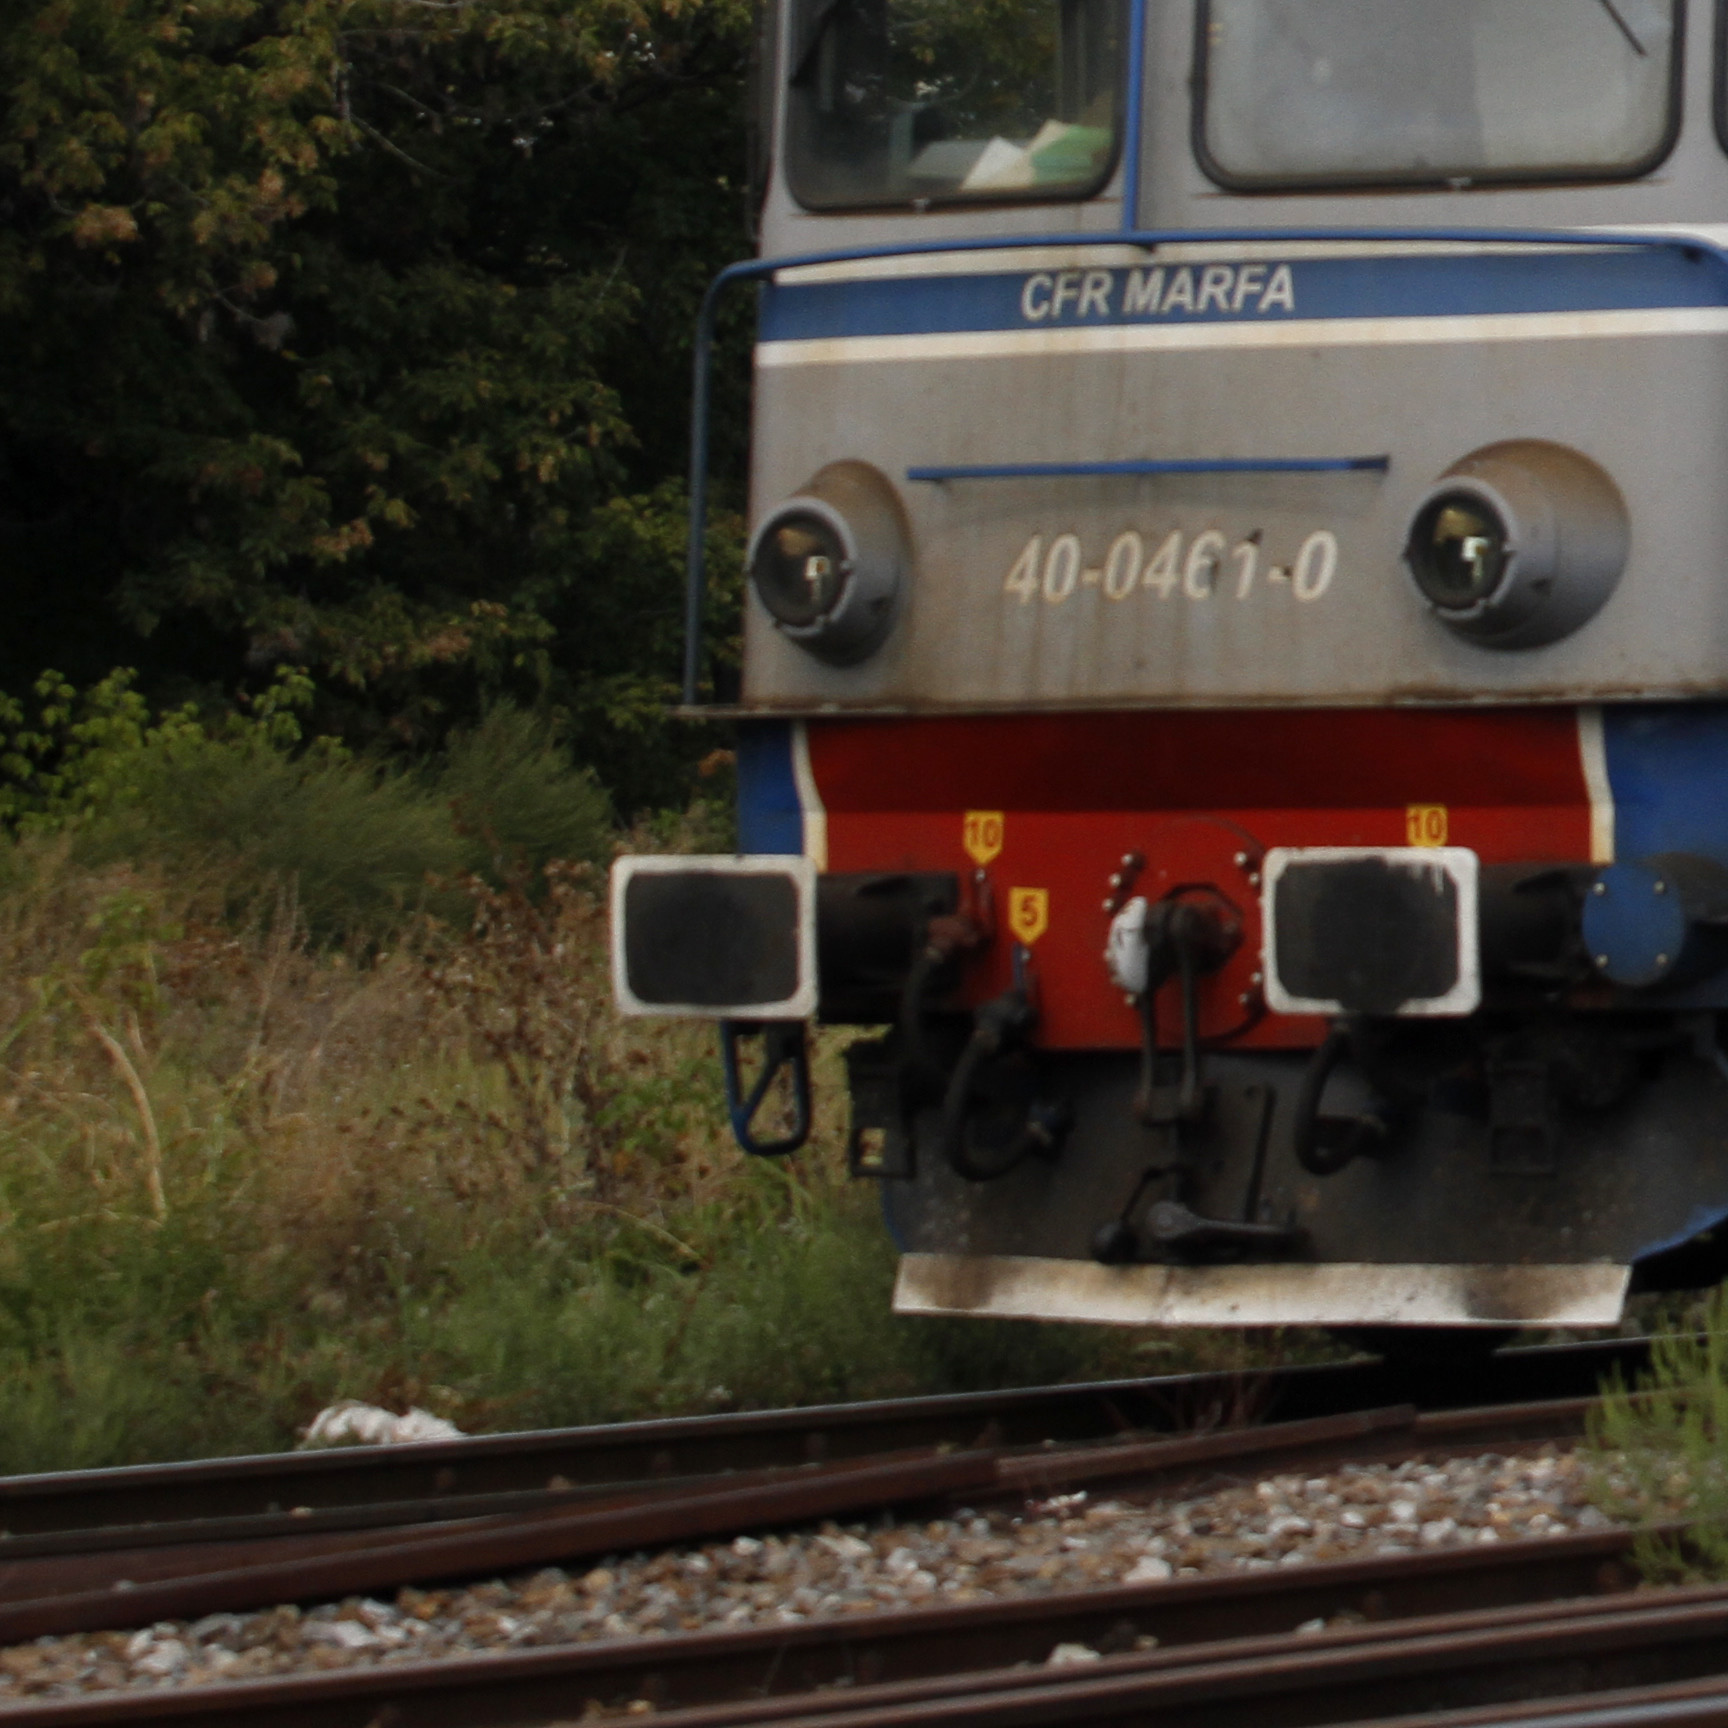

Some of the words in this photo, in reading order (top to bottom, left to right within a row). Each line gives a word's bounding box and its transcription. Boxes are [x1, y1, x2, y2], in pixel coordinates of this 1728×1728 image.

[1021, 270, 1114, 321] CFR
[1122, 263, 1295, 315] MARFA
[1003, 528, 1339, 605] 40-0461-0
[966, 817, 999, 850] 10
[1408, 809, 1444, 844] 10
[1021, 895, 1040, 927] 5
